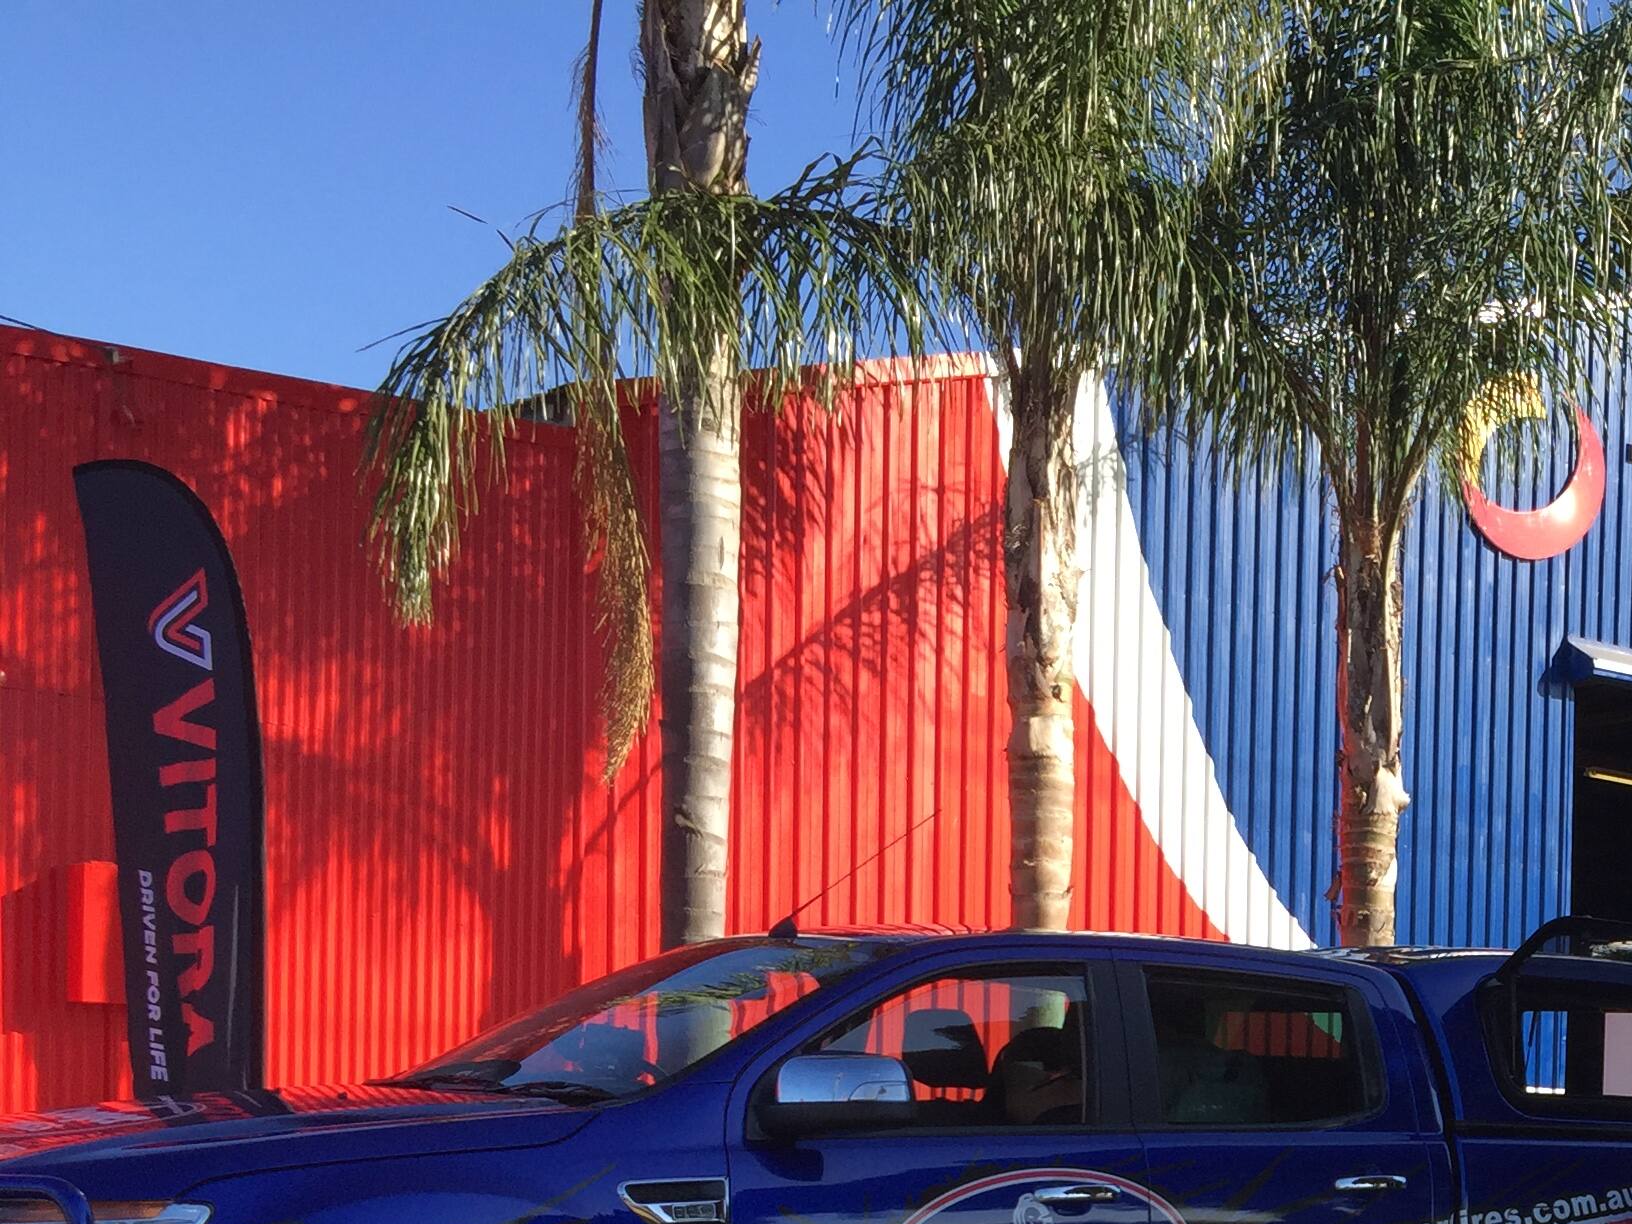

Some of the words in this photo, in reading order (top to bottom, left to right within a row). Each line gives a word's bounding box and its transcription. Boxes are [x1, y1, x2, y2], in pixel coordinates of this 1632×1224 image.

[151, 678, 217, 1056] VITORA
[137, 869, 160, 966] DRIVEN
[145, 970, 161, 1020] FOR
[149, 1025, 169, 1082] LIFE
